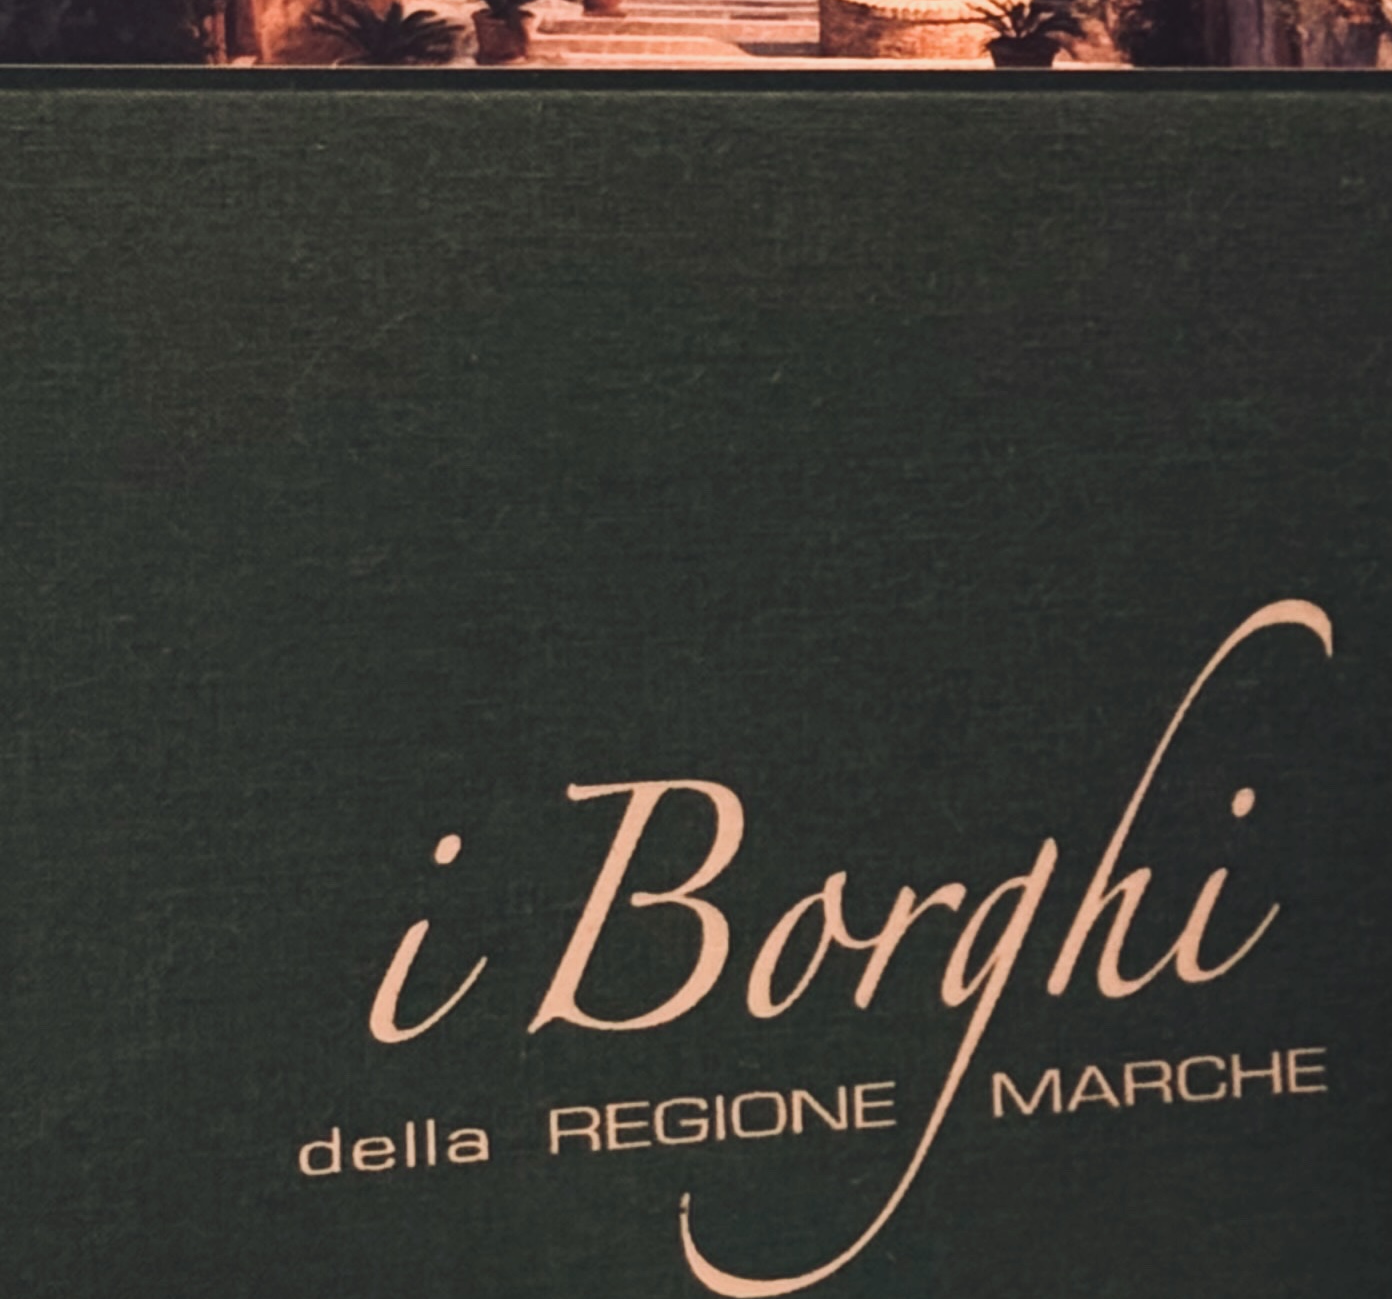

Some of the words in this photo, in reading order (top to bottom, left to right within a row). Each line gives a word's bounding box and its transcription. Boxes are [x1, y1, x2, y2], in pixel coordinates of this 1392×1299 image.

[297, 1119, 492, 1176] della
[547, 1080, 898, 1155] REGIONE
[991, 1046, 1329, 1118] MARCHE
[369, 832, 488, 1045] i
[526, 597, 1334, 1299] Borghi
